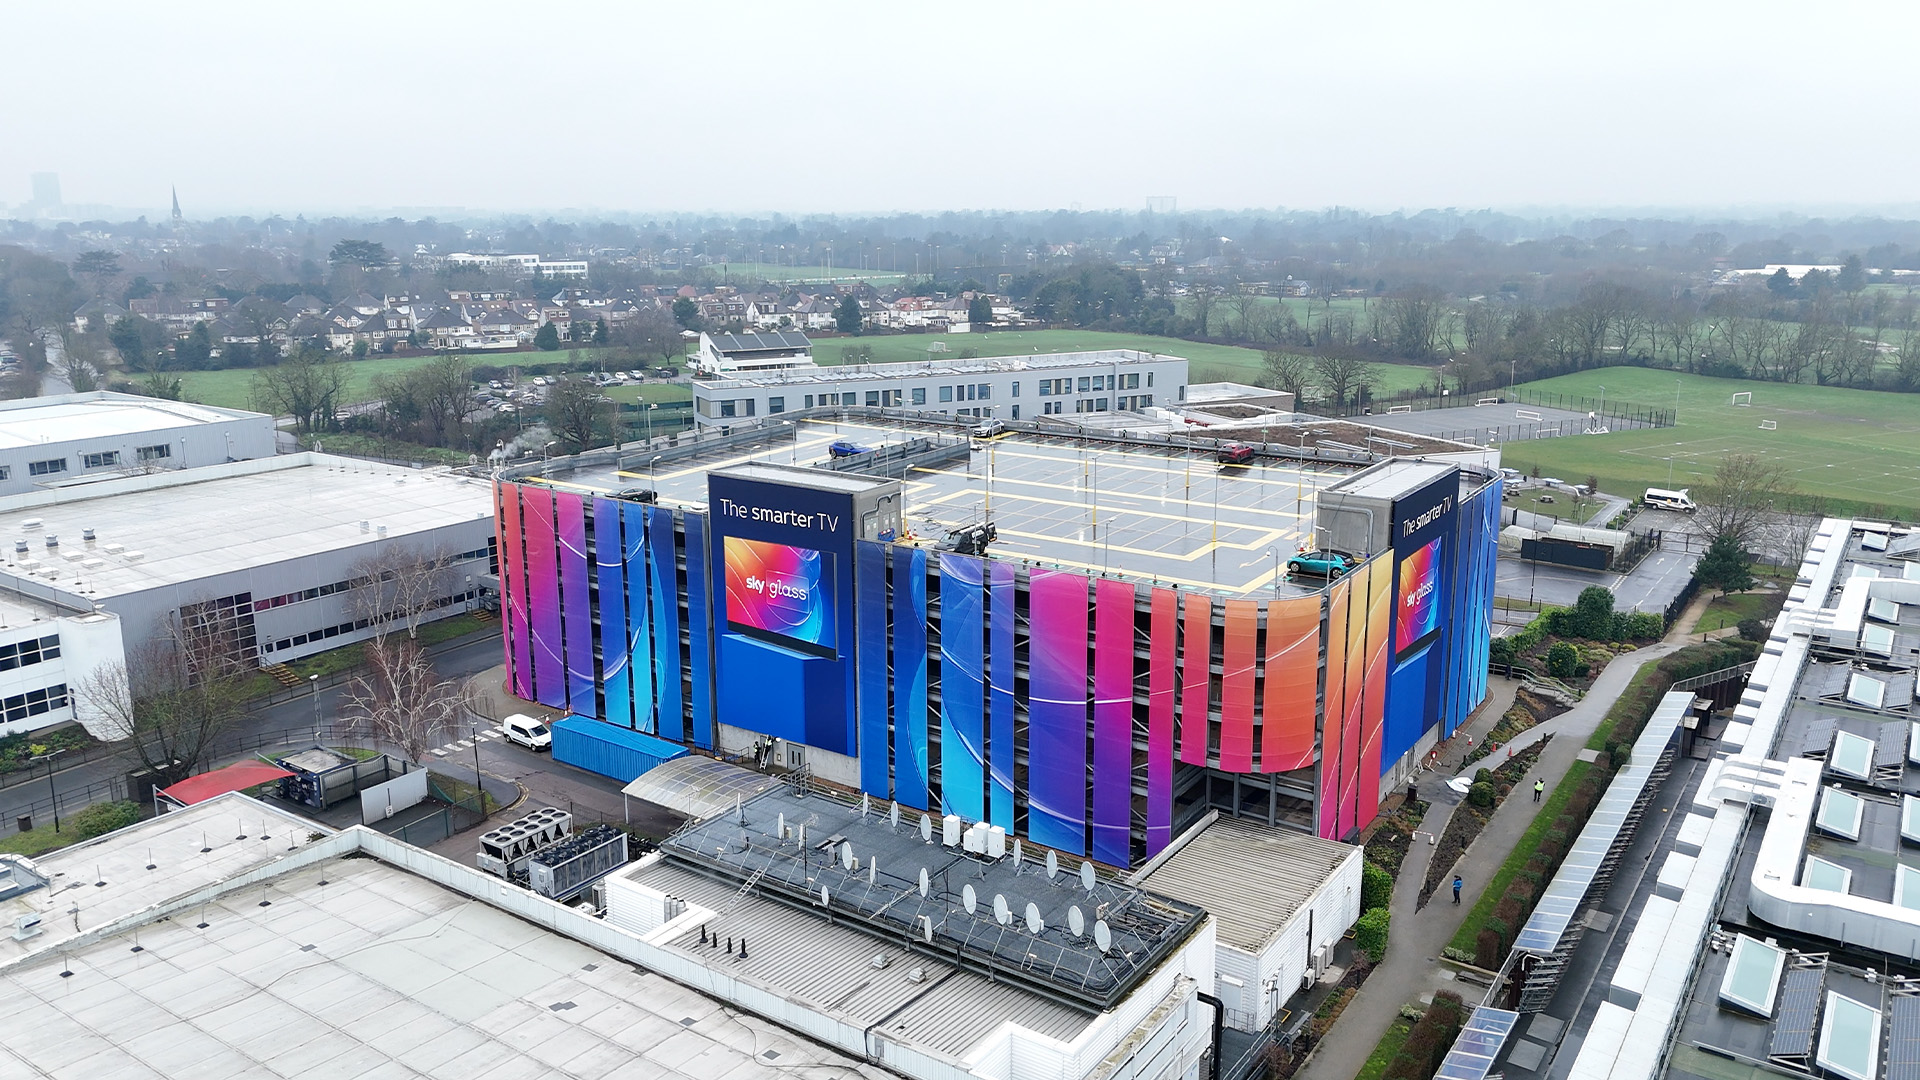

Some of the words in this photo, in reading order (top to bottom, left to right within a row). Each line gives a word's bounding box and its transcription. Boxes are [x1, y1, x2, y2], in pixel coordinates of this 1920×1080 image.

[720, 498, 748, 519] The
[751, 506, 814, 528] smarter
[817, 513, 839, 532] TV
[1403, 519, 1415, 538] The
[1416, 503, 1443, 530] smarter
[1443, 494, 1453, 514] TV
[746, 575, 765, 594] sky
[769, 579, 807, 601] glass
[1406, 590, 1416, 608] sky
[1416, 581, 1433, 606] glass
